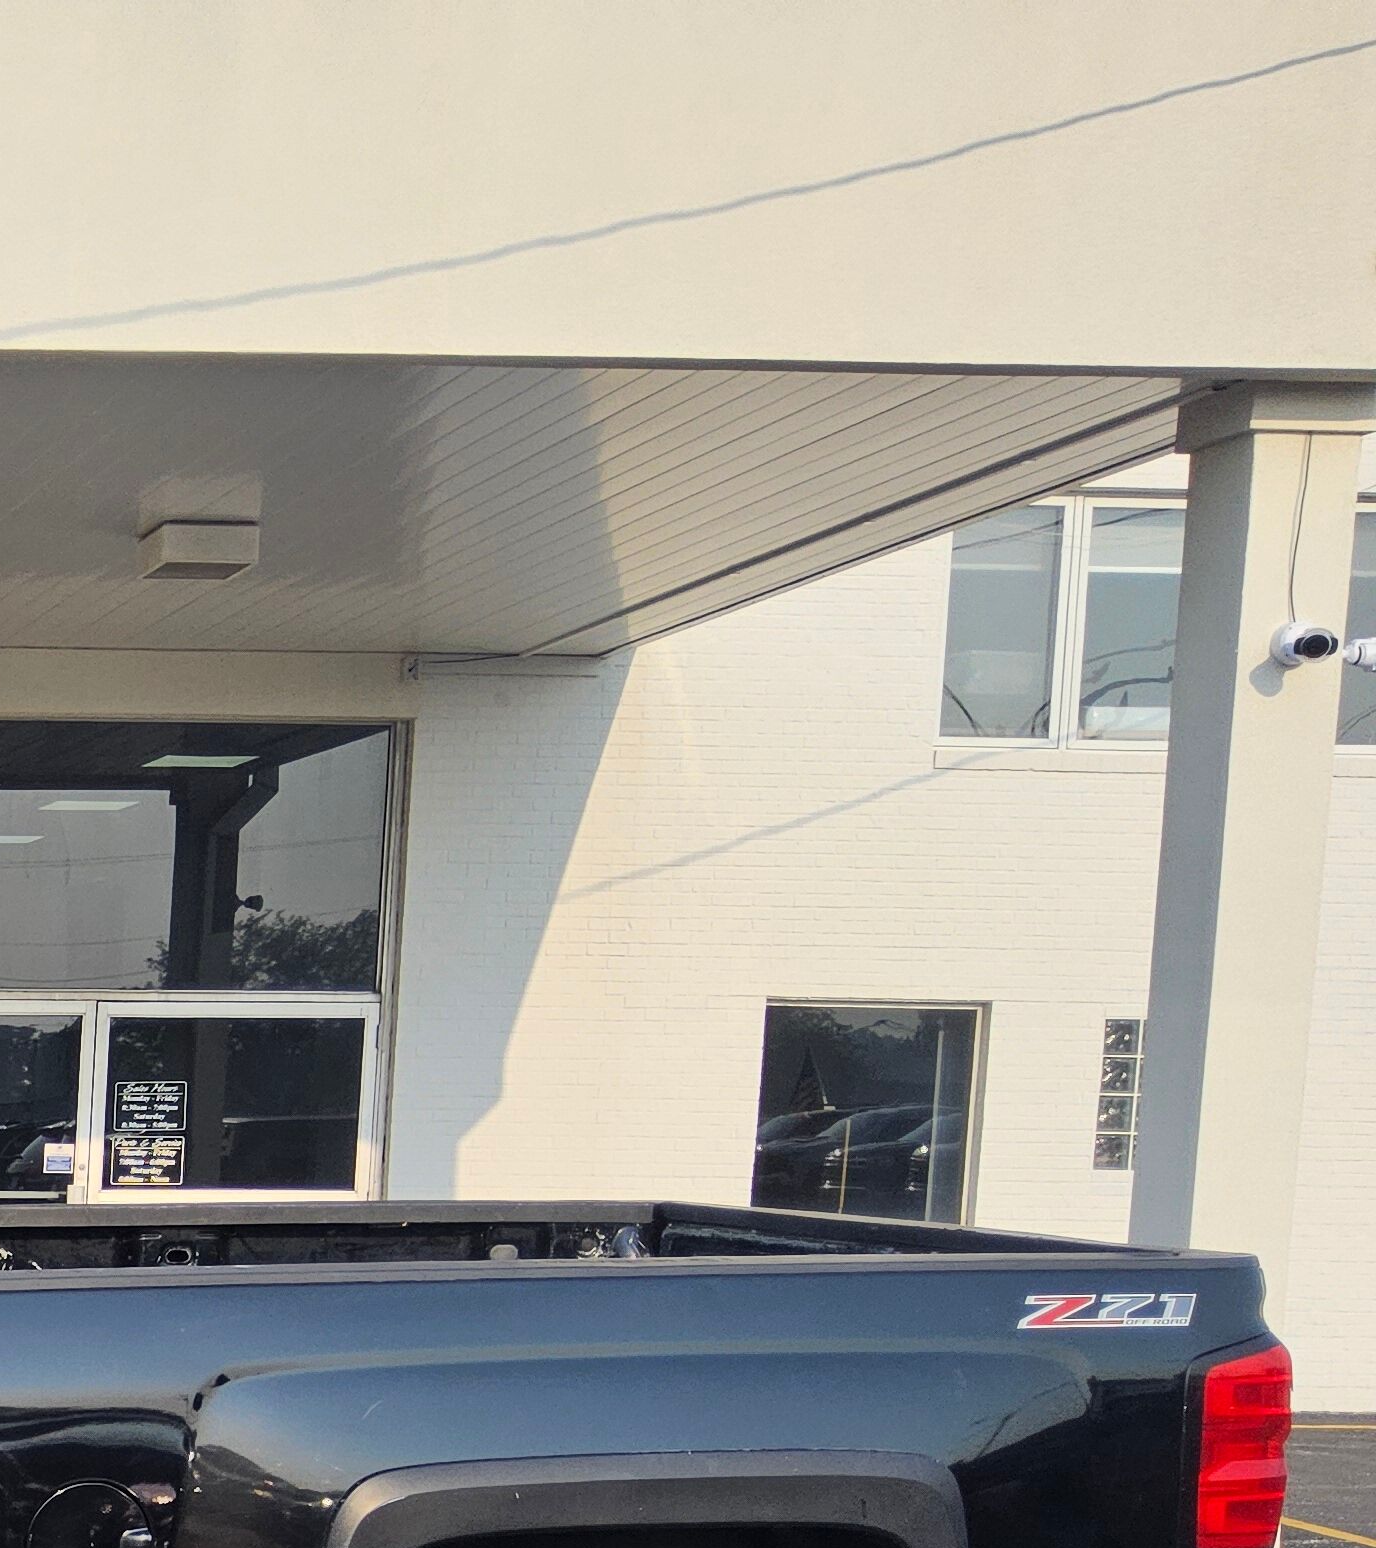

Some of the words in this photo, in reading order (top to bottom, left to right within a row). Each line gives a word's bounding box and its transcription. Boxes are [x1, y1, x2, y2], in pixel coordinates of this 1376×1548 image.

[1017, 1293, 1197, 1330] Z71
[1125, 1318, 1149, 1326] OFF
[1152, 1317, 1188, 1325] ROAD
